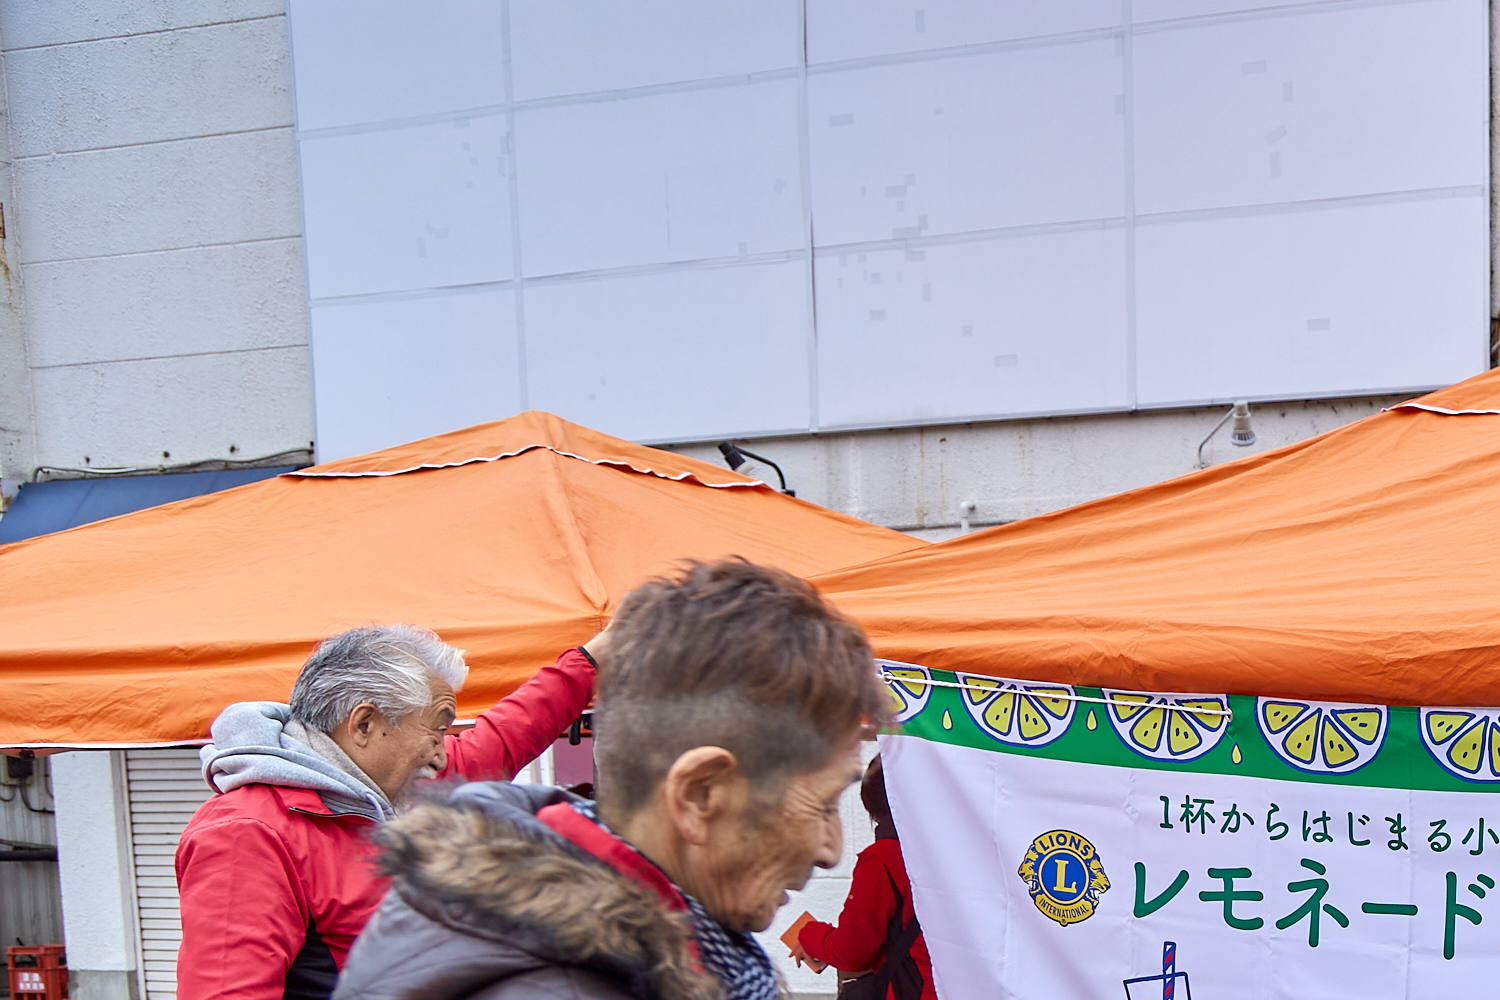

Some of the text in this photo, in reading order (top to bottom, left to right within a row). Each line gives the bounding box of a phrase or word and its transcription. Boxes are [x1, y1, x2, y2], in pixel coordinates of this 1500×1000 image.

[1039, 833, 1091, 856] LIONS
[1053, 858, 1077, 894] L
[1039, 898, 1089, 918] INTERNATIONAL
